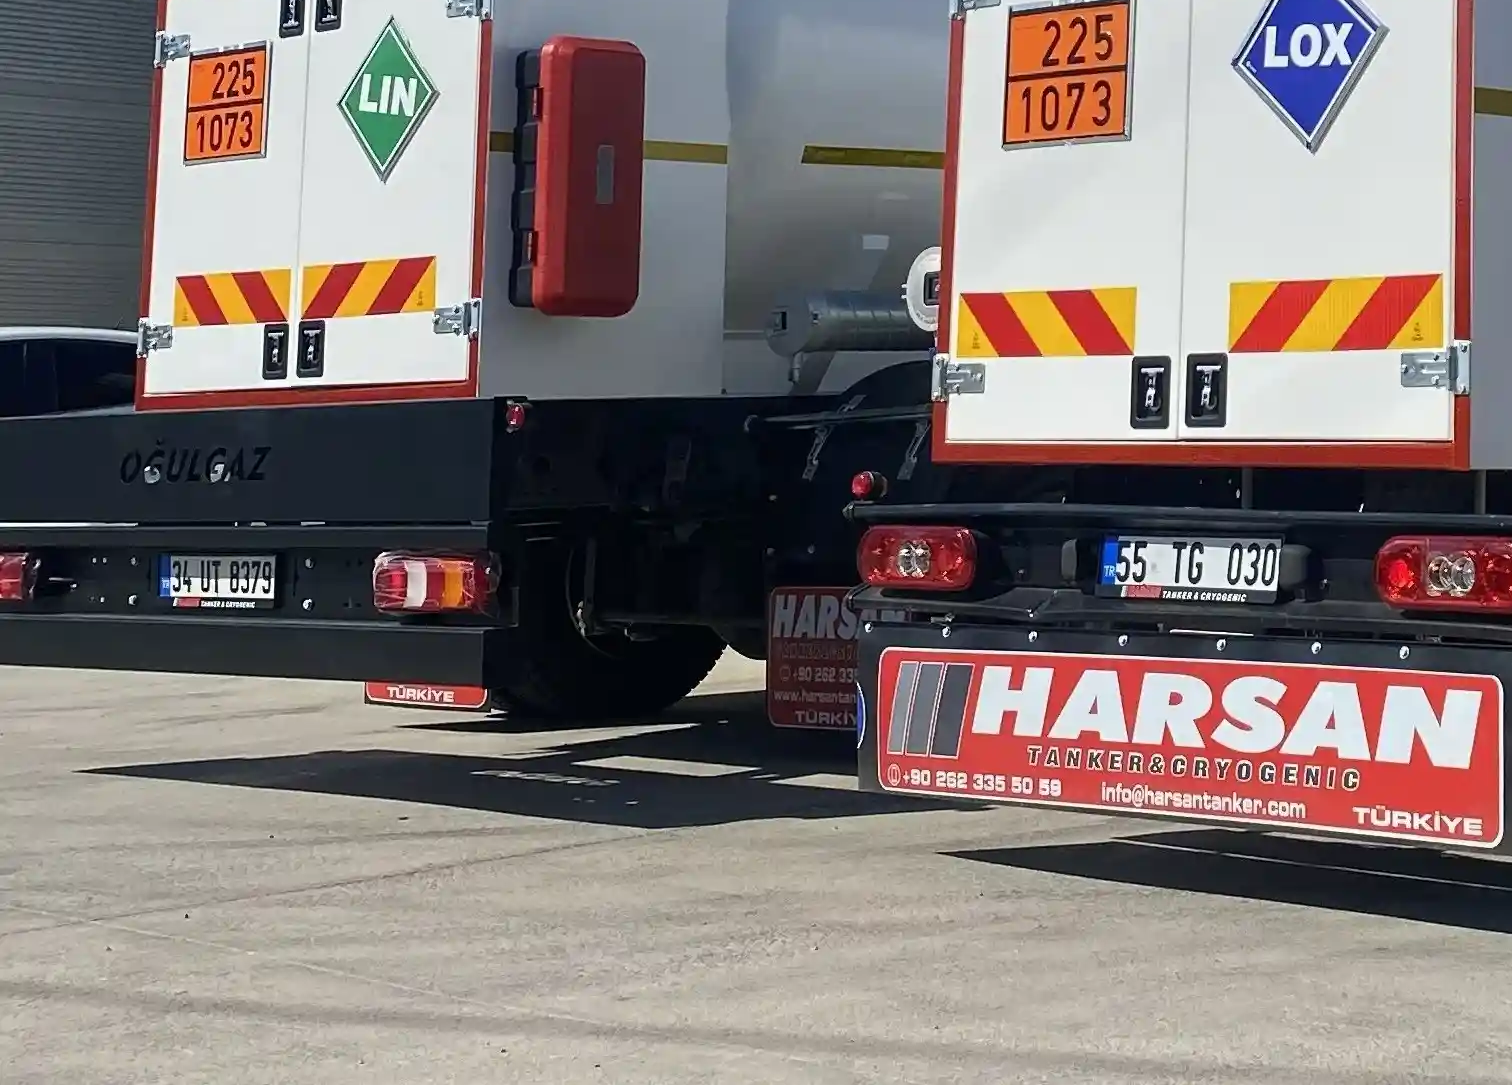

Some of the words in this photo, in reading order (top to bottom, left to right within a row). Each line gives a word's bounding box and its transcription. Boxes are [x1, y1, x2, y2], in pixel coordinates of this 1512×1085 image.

[1042, 13, 1113, 68] 225
[1263, 22, 1353, 68] LOX
[211, 57, 256, 100] 225
[357, 72, 418, 118] LIN
[1021, 79, 1112, 134] 1073
[195, 109, 254, 152] 1073
[119, 436, 272, 485] OĞULGAZ
[172, 560, 192, 593] 34
[200, 560, 221, 594] UT
[229, 560, 272, 594] 8379
[1103, 565, 1115, 578] TR
[1116, 540, 1148, 583] 55
[1172, 541, 1205, 585] TG
[1226, 542, 1278, 587] 030
[772, 594, 906, 640] HARS
[386, 684, 455, 703] TÜRKİYE
[971, 665, 1483, 770] HARSAN
[902, 768, 932, 787] +90
[936, 769, 968, 789] 262
[972, 773, 1006, 792] 335
[1011, 775, 1034, 794] 50
[1038, 777, 1062, 797] 59
[1101, 782, 1306, 819] info@harsantanker.com
[1352, 804, 1483, 836] TÜRKİYE
